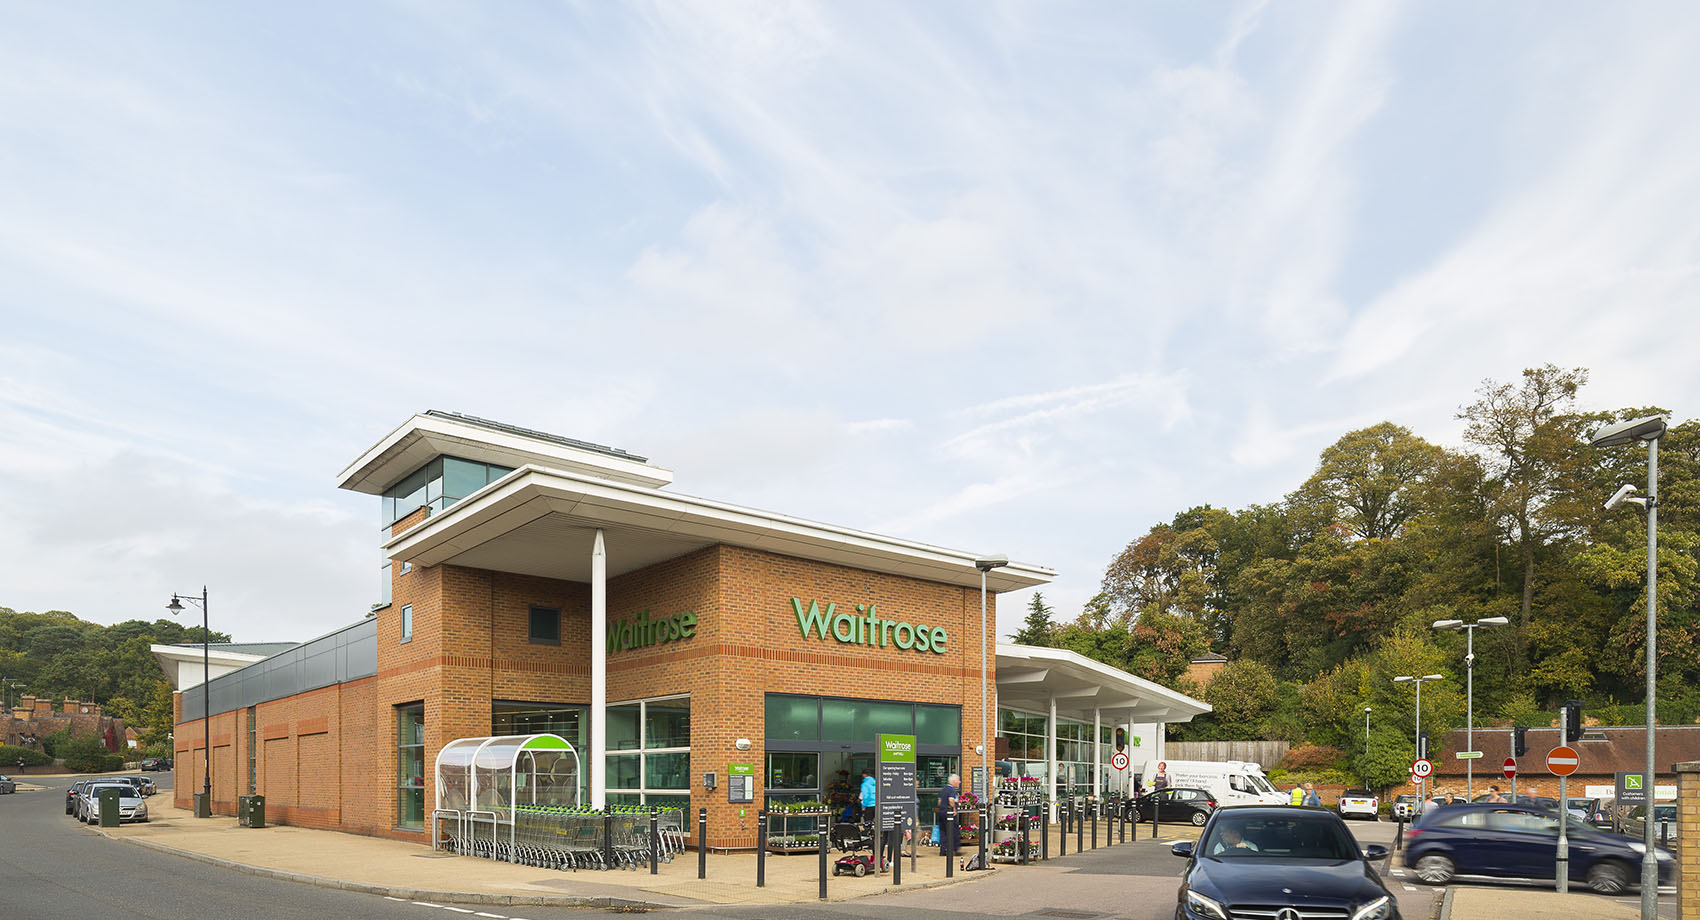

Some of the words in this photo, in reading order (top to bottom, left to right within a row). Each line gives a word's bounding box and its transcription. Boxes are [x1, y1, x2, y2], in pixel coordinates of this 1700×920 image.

[606, 609, 697, 655] Waitrose
[790, 597, 948, 654] Waitrose
[885, 740, 911, 750] Waitrose
[1416, 764, 1428, 772] 10
